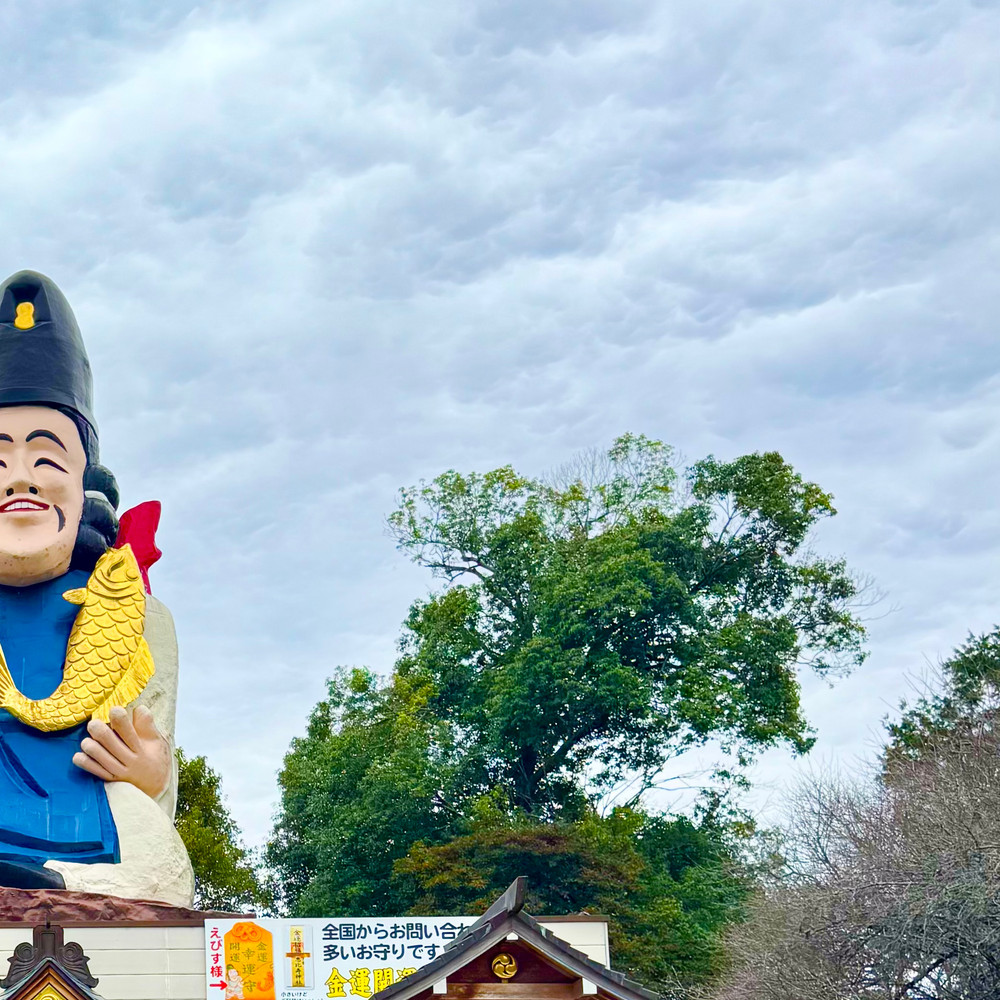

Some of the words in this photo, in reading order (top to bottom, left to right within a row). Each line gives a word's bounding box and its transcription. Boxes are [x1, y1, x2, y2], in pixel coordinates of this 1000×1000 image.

[210, 927, 223, 978] えびす様
[229, 942, 240, 962] 開運
[256, 942, 268, 962] 金運
[323, 944, 440, 961] 多いお守りです
[242, 948, 256, 992] 幸運守
